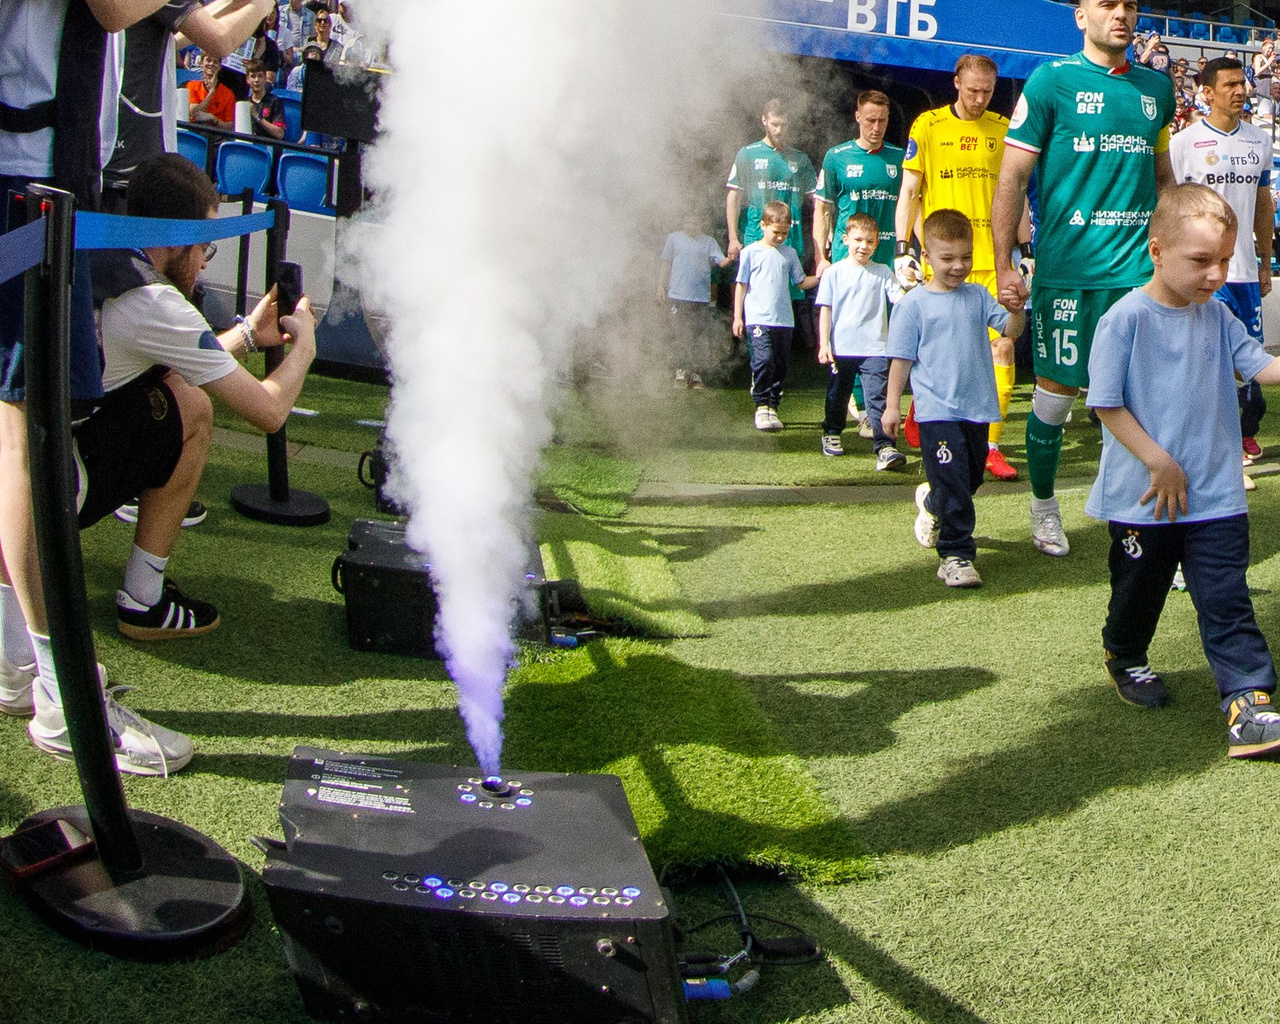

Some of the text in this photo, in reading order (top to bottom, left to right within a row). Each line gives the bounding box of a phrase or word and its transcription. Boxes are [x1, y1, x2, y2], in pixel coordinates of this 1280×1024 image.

[1075, 91, 1104, 103] FON
[1077, 102, 1105, 114] BET
[960, 136, 978, 144] FON
[1099, 133, 1147, 145] КАЗАНЬ
[960, 143, 978, 151] BET
[1053, 298, 1078, 310] FON
[1053, 309, 1078, 322] BET
[1052, 328, 1078, 366] 15
